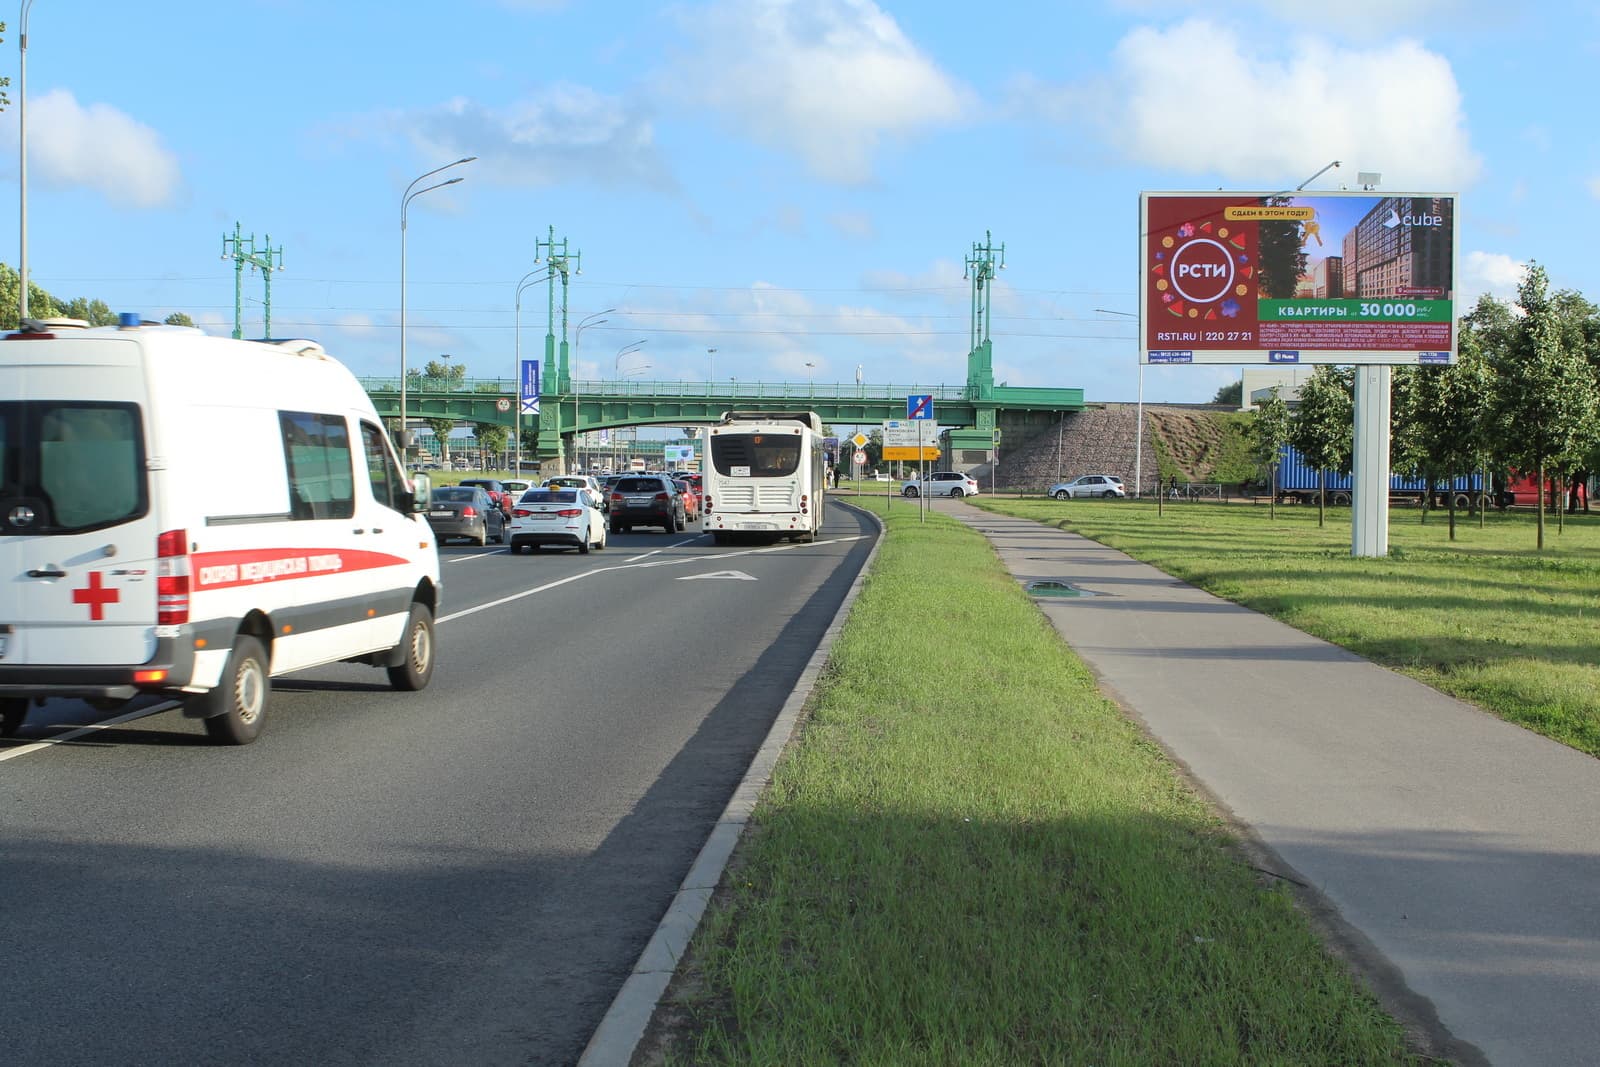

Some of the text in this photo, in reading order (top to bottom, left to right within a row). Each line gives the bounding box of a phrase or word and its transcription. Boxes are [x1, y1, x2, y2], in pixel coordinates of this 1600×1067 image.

[1402, 212, 1443, 227] cube
[1179, 262, 1226, 278] РСТИ
[1278, 306, 1348, 317] КВАРТИРЫ
[1359, 303, 1380, 317] 30
[1382, 303, 1416, 317] 000
[1157, 332, 1252, 341] RSTI.RU 220 27 21
